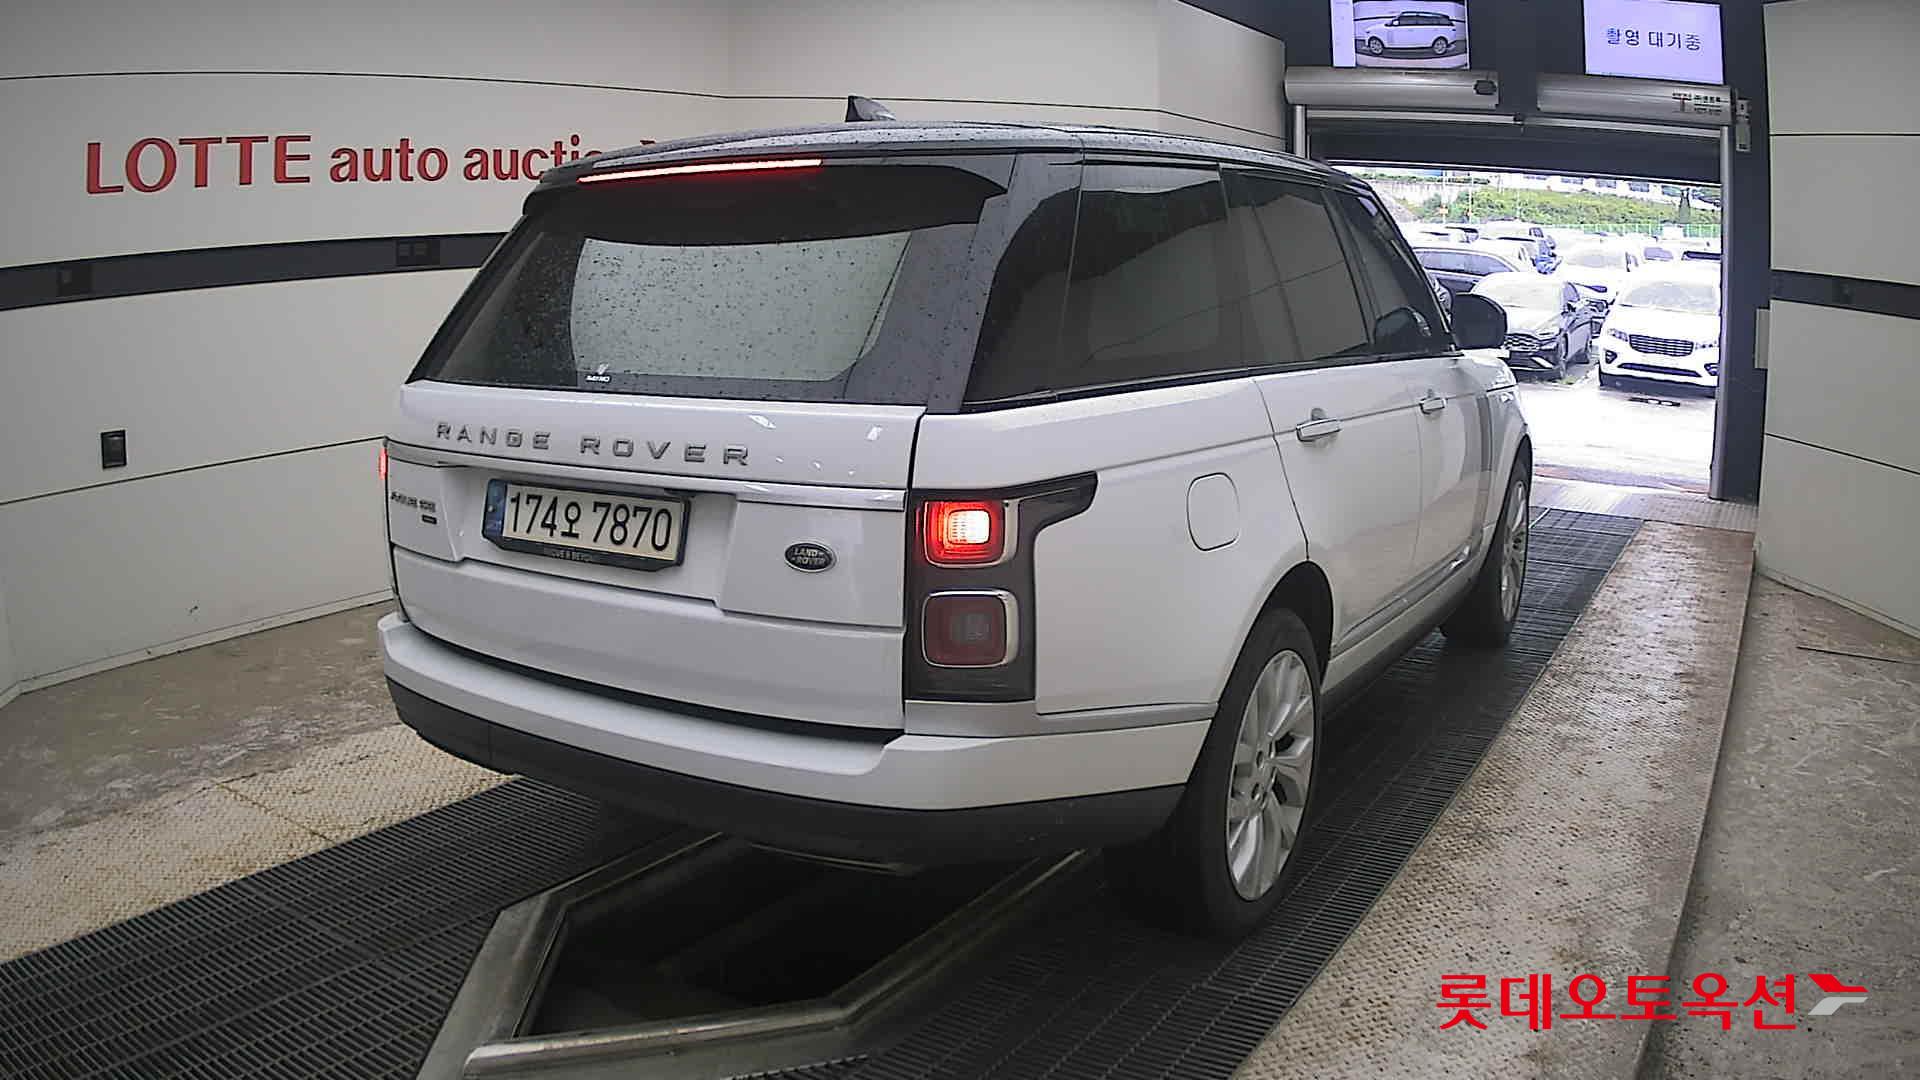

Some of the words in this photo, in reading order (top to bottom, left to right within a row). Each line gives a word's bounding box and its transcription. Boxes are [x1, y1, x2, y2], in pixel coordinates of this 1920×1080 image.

[1647, 31, 1702, 51] 대기중
[86, 135, 311, 195] LOTTE
[330, 139, 449, 183] auto
[436, 422, 551, 450] RANGE
[579, 436, 748, 467] ROVER
[510, 491, 582, 540] 174오
[591, 500, 673, 552] 7870
